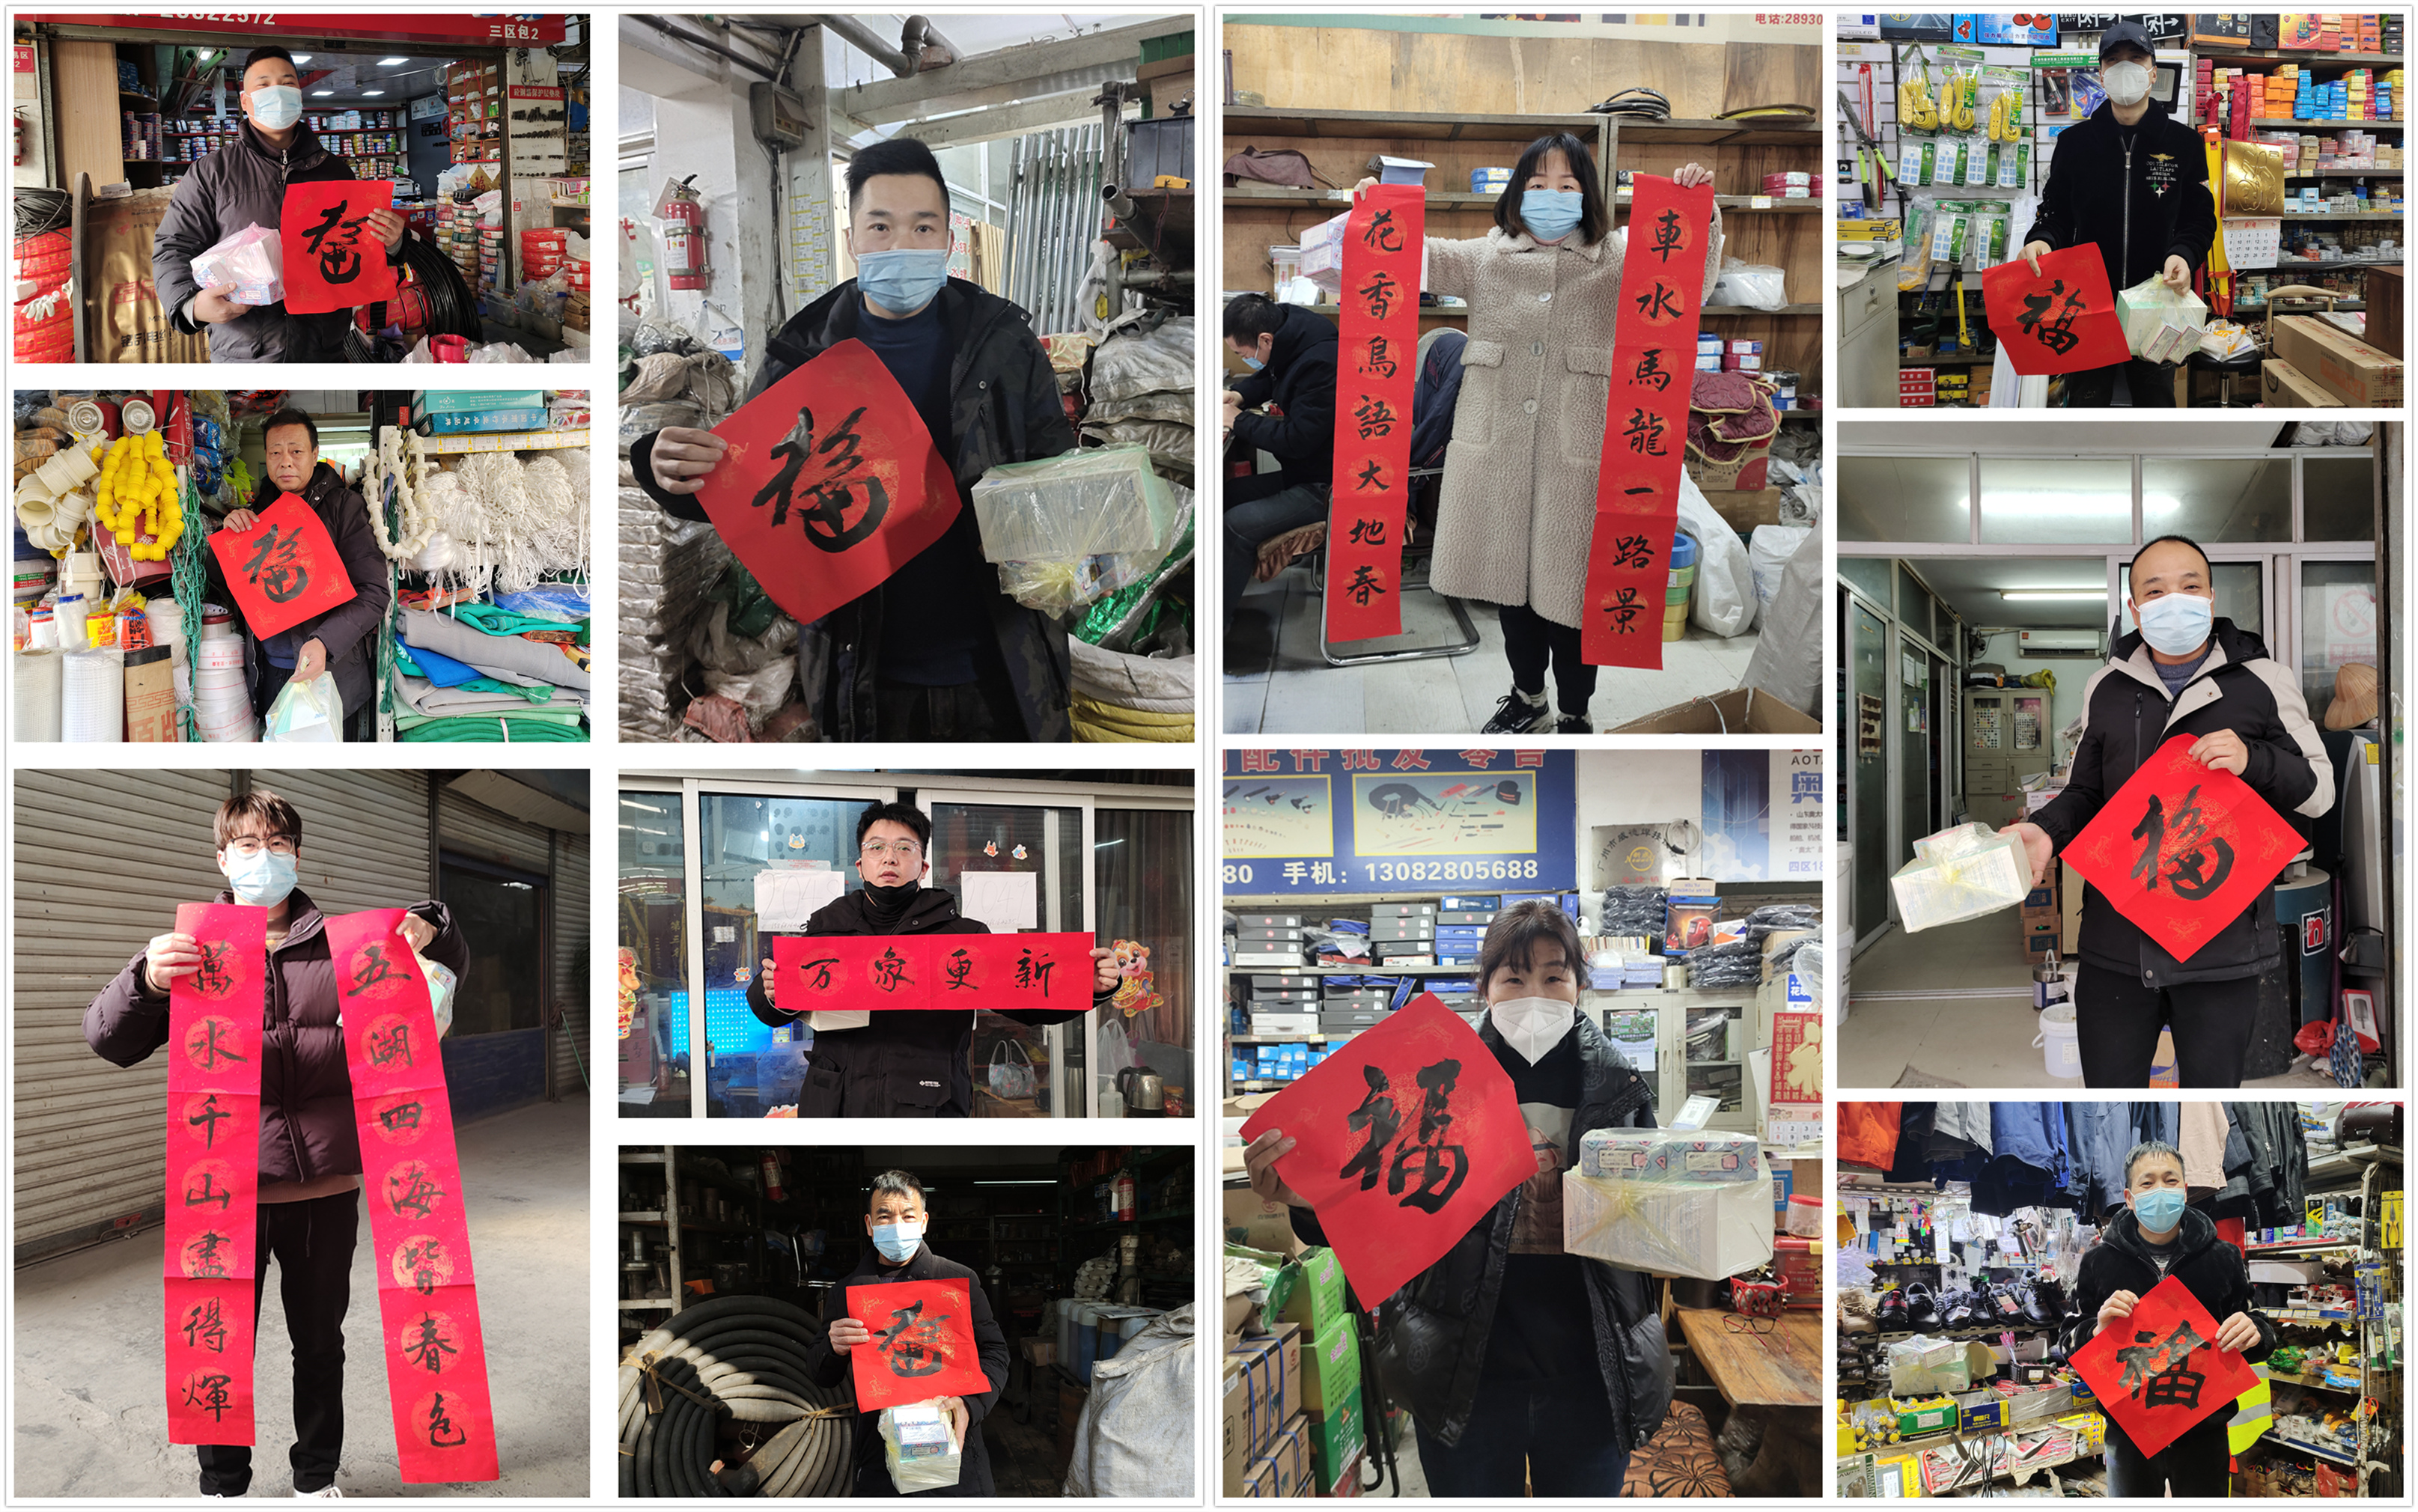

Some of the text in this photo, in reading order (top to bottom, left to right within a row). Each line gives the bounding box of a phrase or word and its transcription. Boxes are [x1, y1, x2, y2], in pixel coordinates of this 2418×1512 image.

[489, 24, 539, 40] 三区包2
[2015, 279, 2087, 355] 福
[1345, 209, 1403, 607] 花香鳥語大地春
[1603, 209, 1684, 635] 車水馬龍一路景
[751, 406, 889, 554] 福
[1222, 749, 1431, 772] 配件批发
[1791, 755, 1823, 765] AOT
[1365, 859, 1539, 882] 13082805688
[2131, 784, 2235, 900] 福
[800, 946, 1054, 998] 万象更新
[1339, 1057, 1470, 1214] 福
[347, 945, 468, 1449] 五湖四海皆春色
[2117, 1319, 2212, 1409] 福
